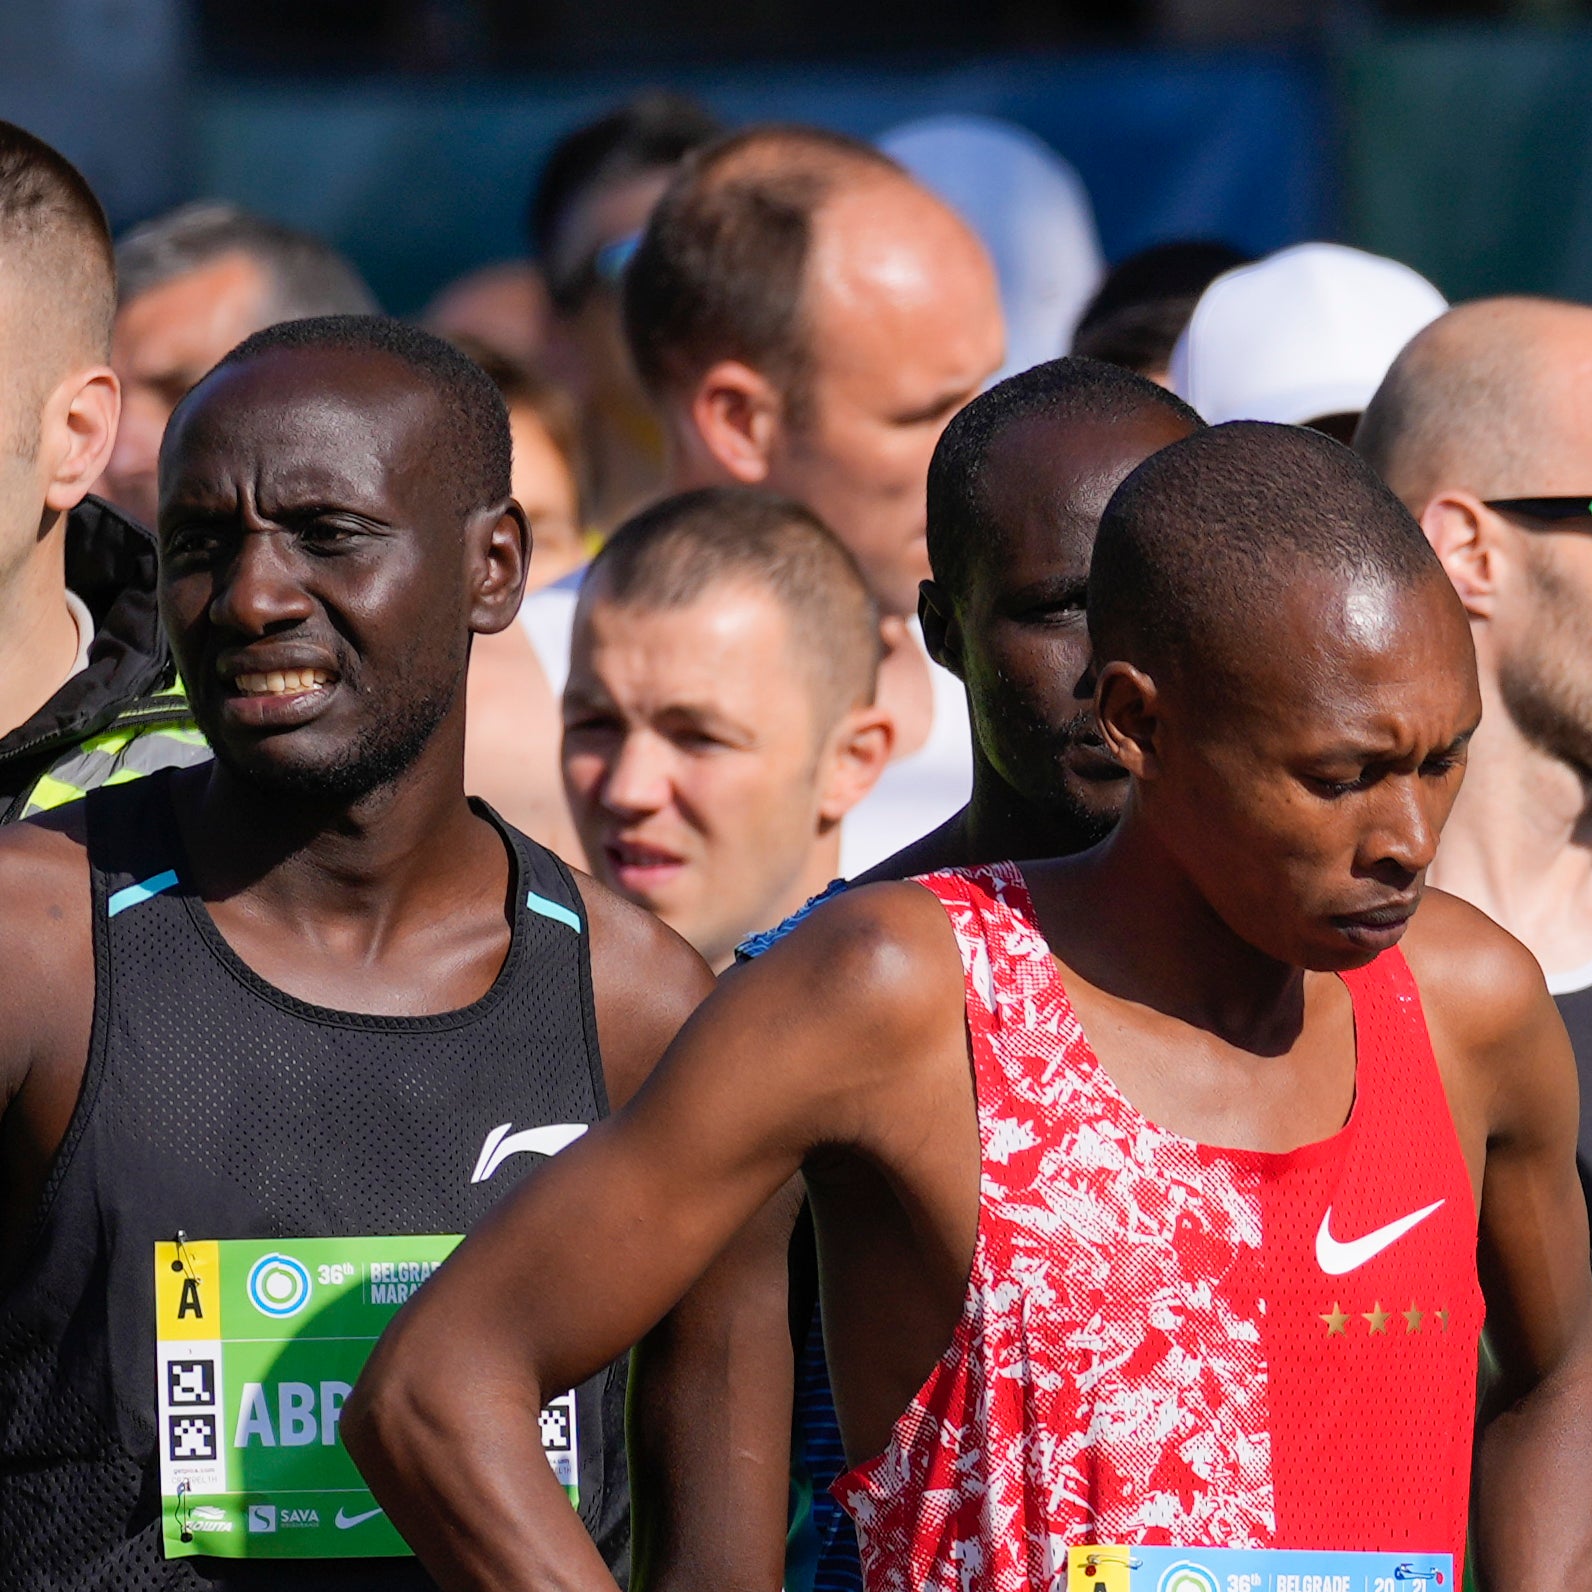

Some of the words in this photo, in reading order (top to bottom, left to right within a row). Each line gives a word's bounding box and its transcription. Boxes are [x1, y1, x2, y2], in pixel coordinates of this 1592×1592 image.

[318, 1262, 354, 1285] 36th
[370, 1261, 441, 1283] BELGRA
[177, 1278, 203, 1320] A
[371, 1283, 423, 1304] MARA
[280, 1508, 320, 1522] SAVA
